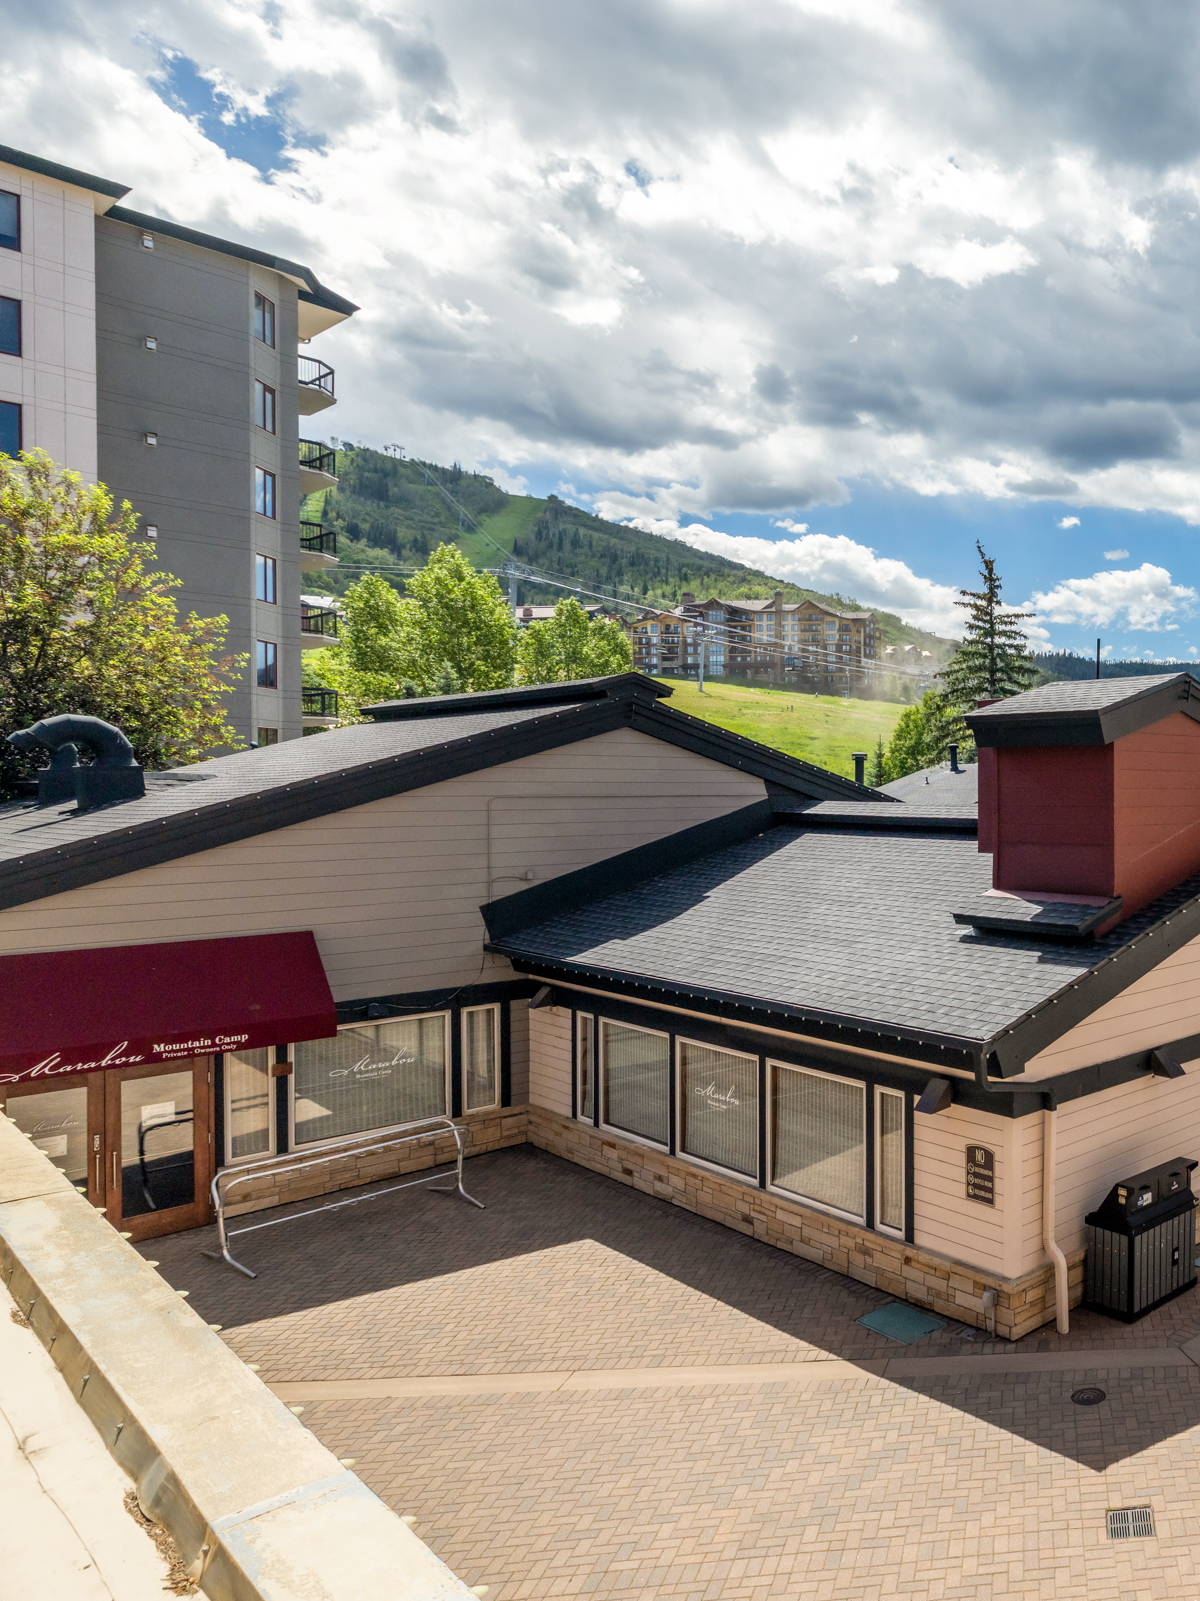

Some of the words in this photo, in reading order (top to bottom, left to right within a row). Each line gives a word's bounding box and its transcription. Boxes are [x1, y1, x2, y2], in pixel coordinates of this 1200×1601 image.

[152, 1038, 212, 1053] Mountain
[215, 1034, 249, 1044] Camp
[194, 1046, 220, 1054] Owners
[0, 1041, 145, 1083] Marabou
[329, 1047, 415, 1076] Marabou
[694, 1081, 740, 1105] Marabou
[975, 1149, 985, 1163] NO
